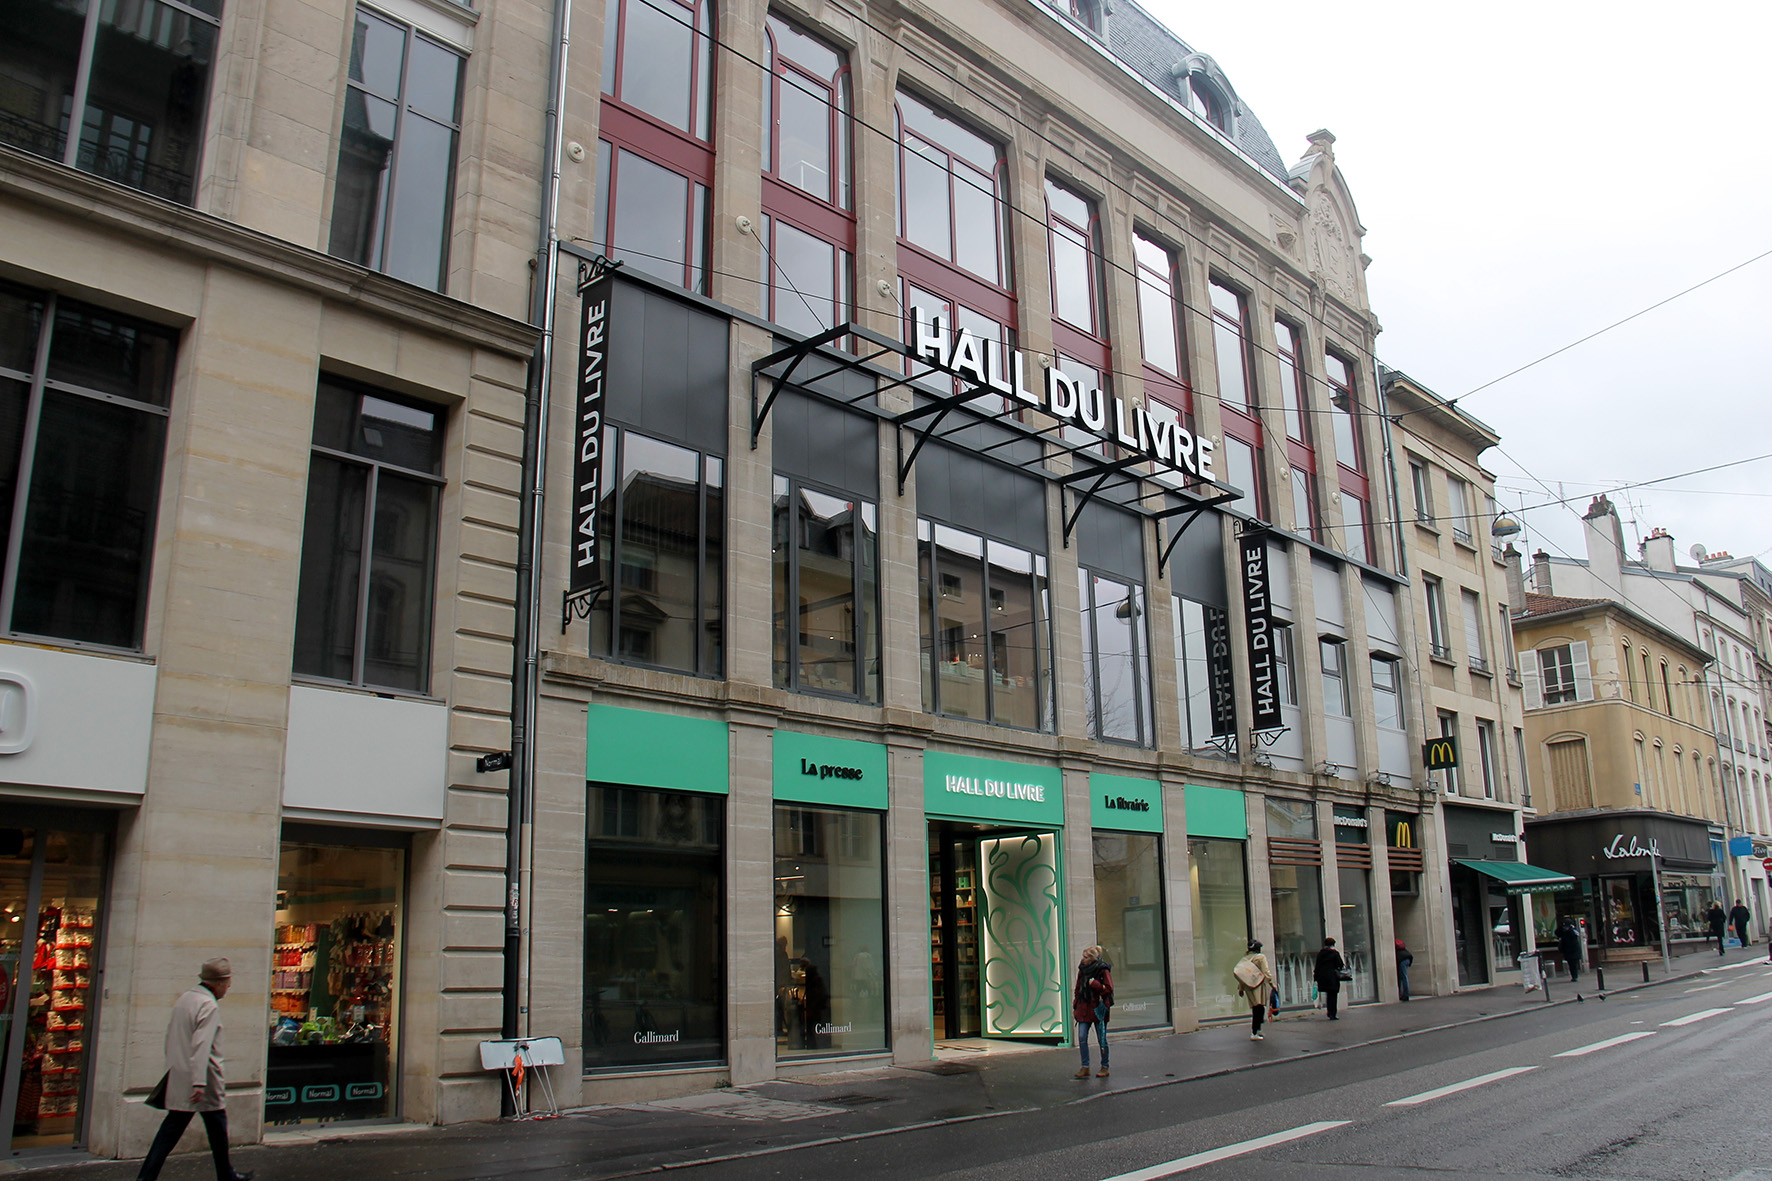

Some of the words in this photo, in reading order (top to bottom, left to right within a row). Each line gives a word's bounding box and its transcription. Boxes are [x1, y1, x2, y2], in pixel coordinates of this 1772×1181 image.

[584, 299, 606, 404] LIVRE
[911, 305, 1039, 406] HALL
[1045, 366, 1105, 431] DU
[1115, 397, 1216, 483] LIVRE
[581, 410, 599, 464] DU
[577, 468, 597, 568] HALL
[1246, 547, 1266, 613] LIVRE
[1251, 616, 1269, 650] DU
[1255, 653, 1274, 715] HALL
[801, 758, 818, 776] La
[820, 764, 864, 780] presse
[945, 774, 984, 796] HALL
[984, 778, 1005, 798] DU
[1006, 782, 1045, 802] LIVRE
[1104, 795, 1116, 809] La
[1116, 796, 1150, 812] librairie
[633, 1030, 679, 1044] Gallimard
[815, 1021, 852, 1035] Gallimard
[308, 1088, 333, 1099] Normal
[352, 1086, 376, 1096] Normal
